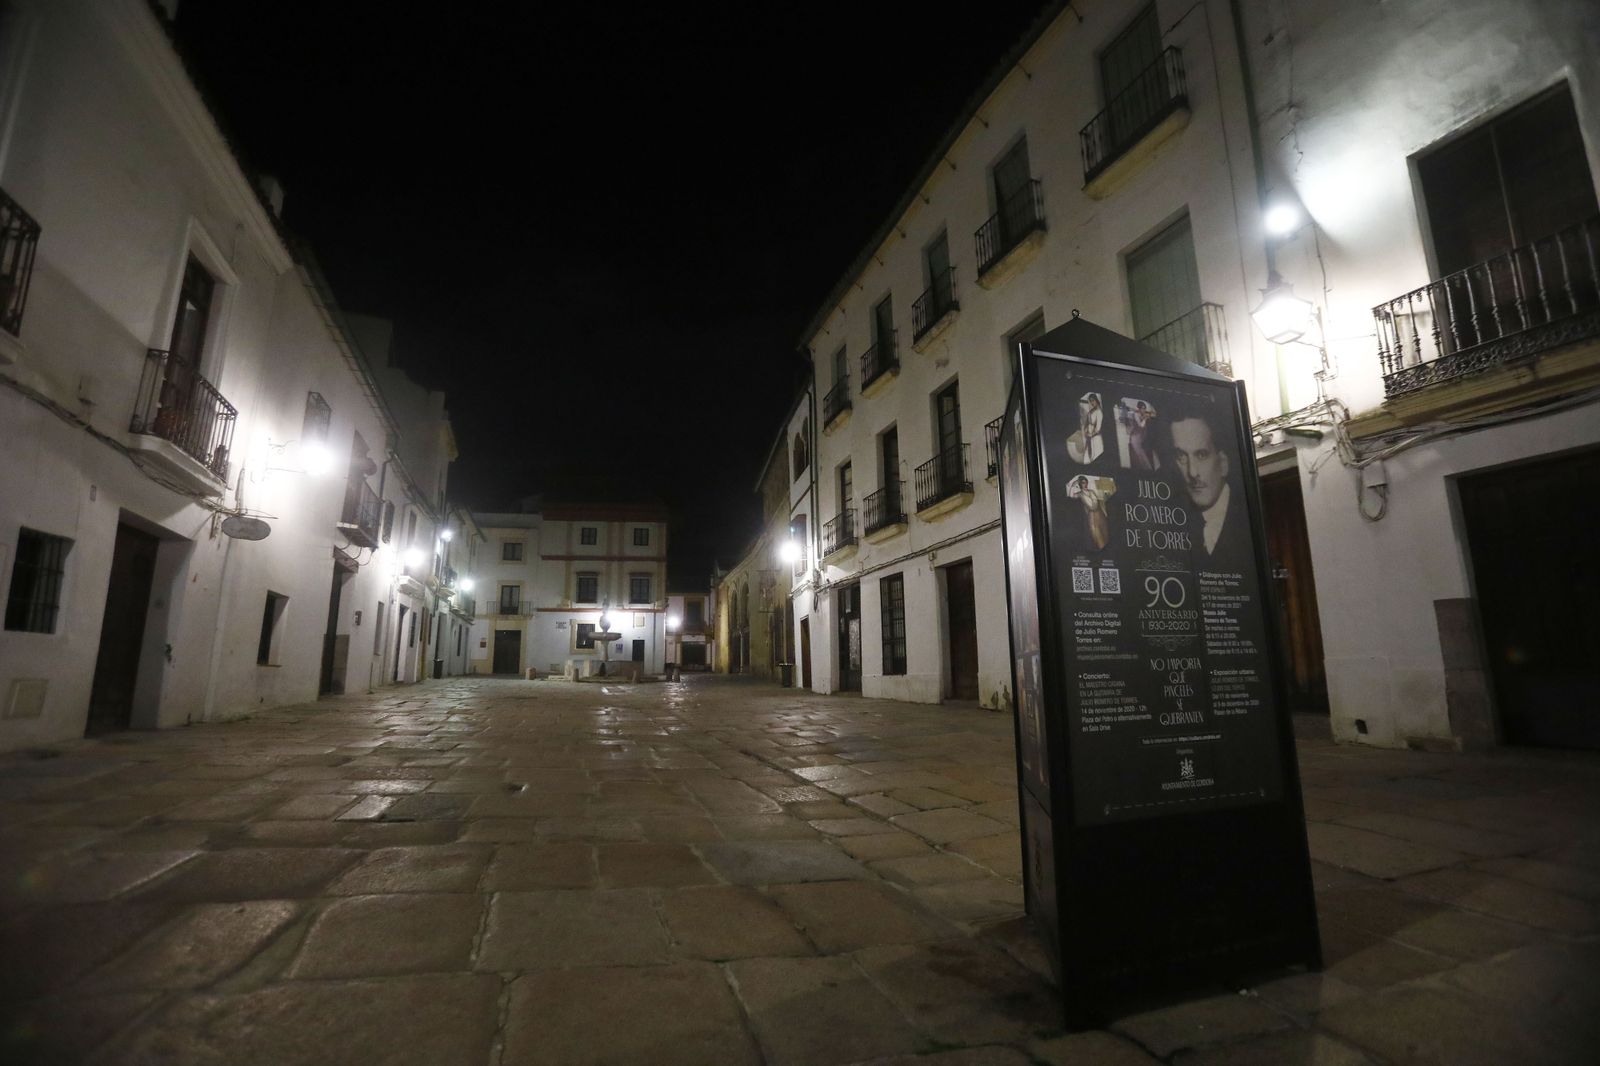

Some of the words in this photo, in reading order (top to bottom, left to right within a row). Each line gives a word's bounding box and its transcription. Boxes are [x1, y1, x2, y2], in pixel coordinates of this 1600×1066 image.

[1138, 479, 1171, 500] JULIO
[1125, 503, 1187, 526] ROMERO
[1126, 528, 1143, 548] DE
[1147, 529, 1192, 551] TORRES
[1144, 576, 1186, 608] 90
[1138, 609, 1199, 620] ANIVERSARIO
[1104, 620, 1122, 628] Digital
[1150, 657, 1165, 671] NO
[1167, 657, 1202, 670] IMPORTA
[1164, 684, 1194, 698] PINCELES
